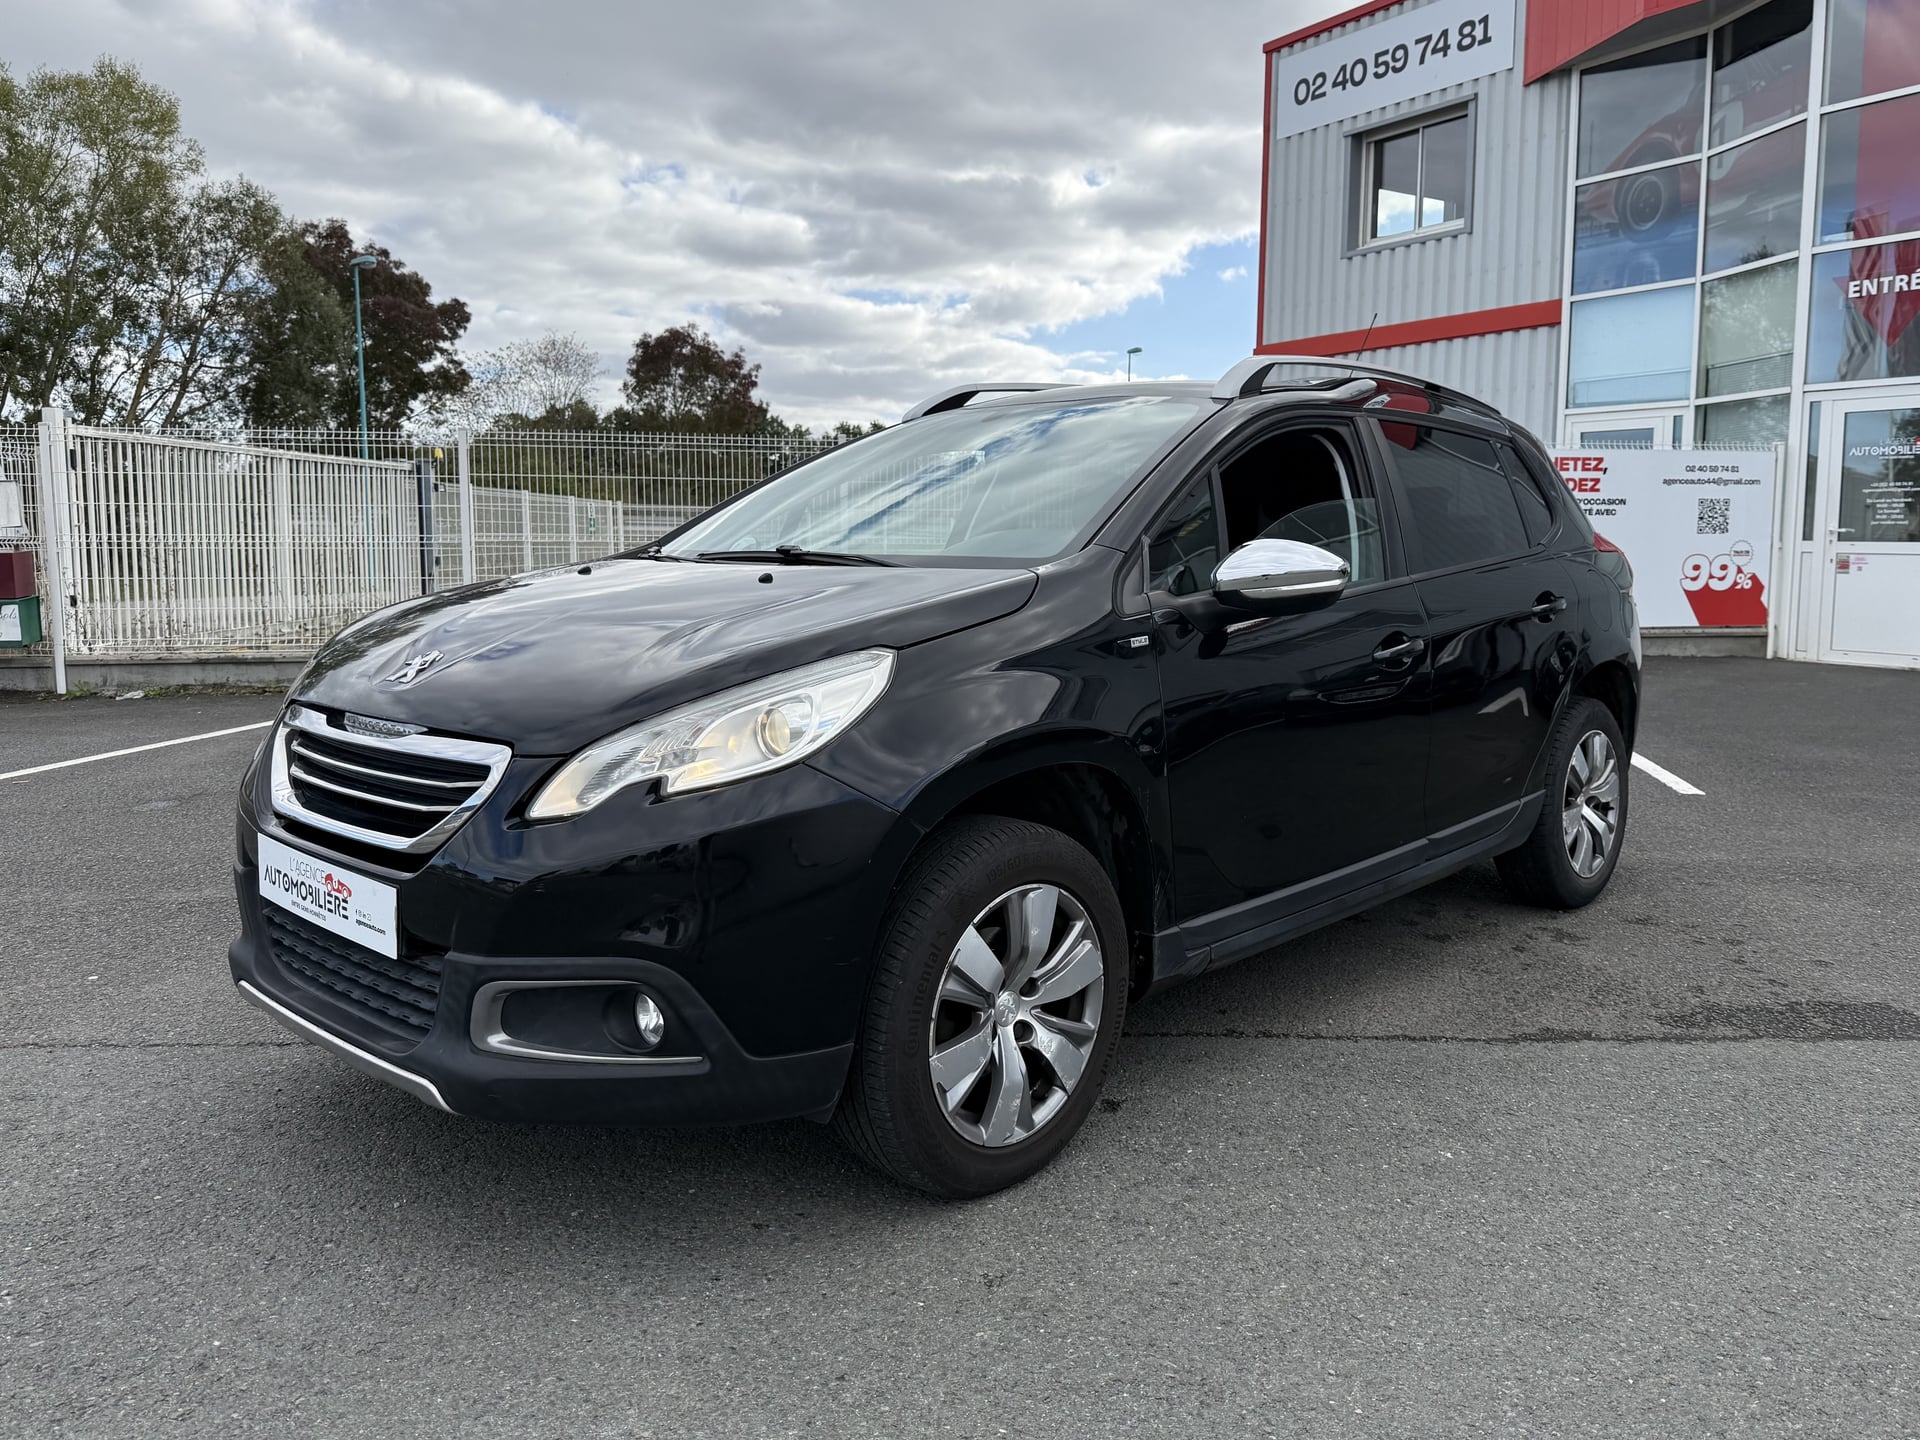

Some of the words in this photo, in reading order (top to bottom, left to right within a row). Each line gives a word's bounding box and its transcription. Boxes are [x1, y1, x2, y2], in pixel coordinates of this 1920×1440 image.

[1294, 72, 1327, 106] 02
[1331, 58, 1367, 91] 40
[1373, 43, 1409, 79] 59
[1414, 28, 1451, 66] 74
[1457, 14, 1492, 52] 81
[1685, 465, 1696, 473] 02
[1697, 465, 1708, 473] 40
[1720, 465, 1730, 473] 74
[1565, 478, 1601, 492] DEZ
[1594, 508, 1617, 516] AVEC
[1680, 553, 1753, 592] 99%
[289, 856, 326, 885] L'AGENCE
